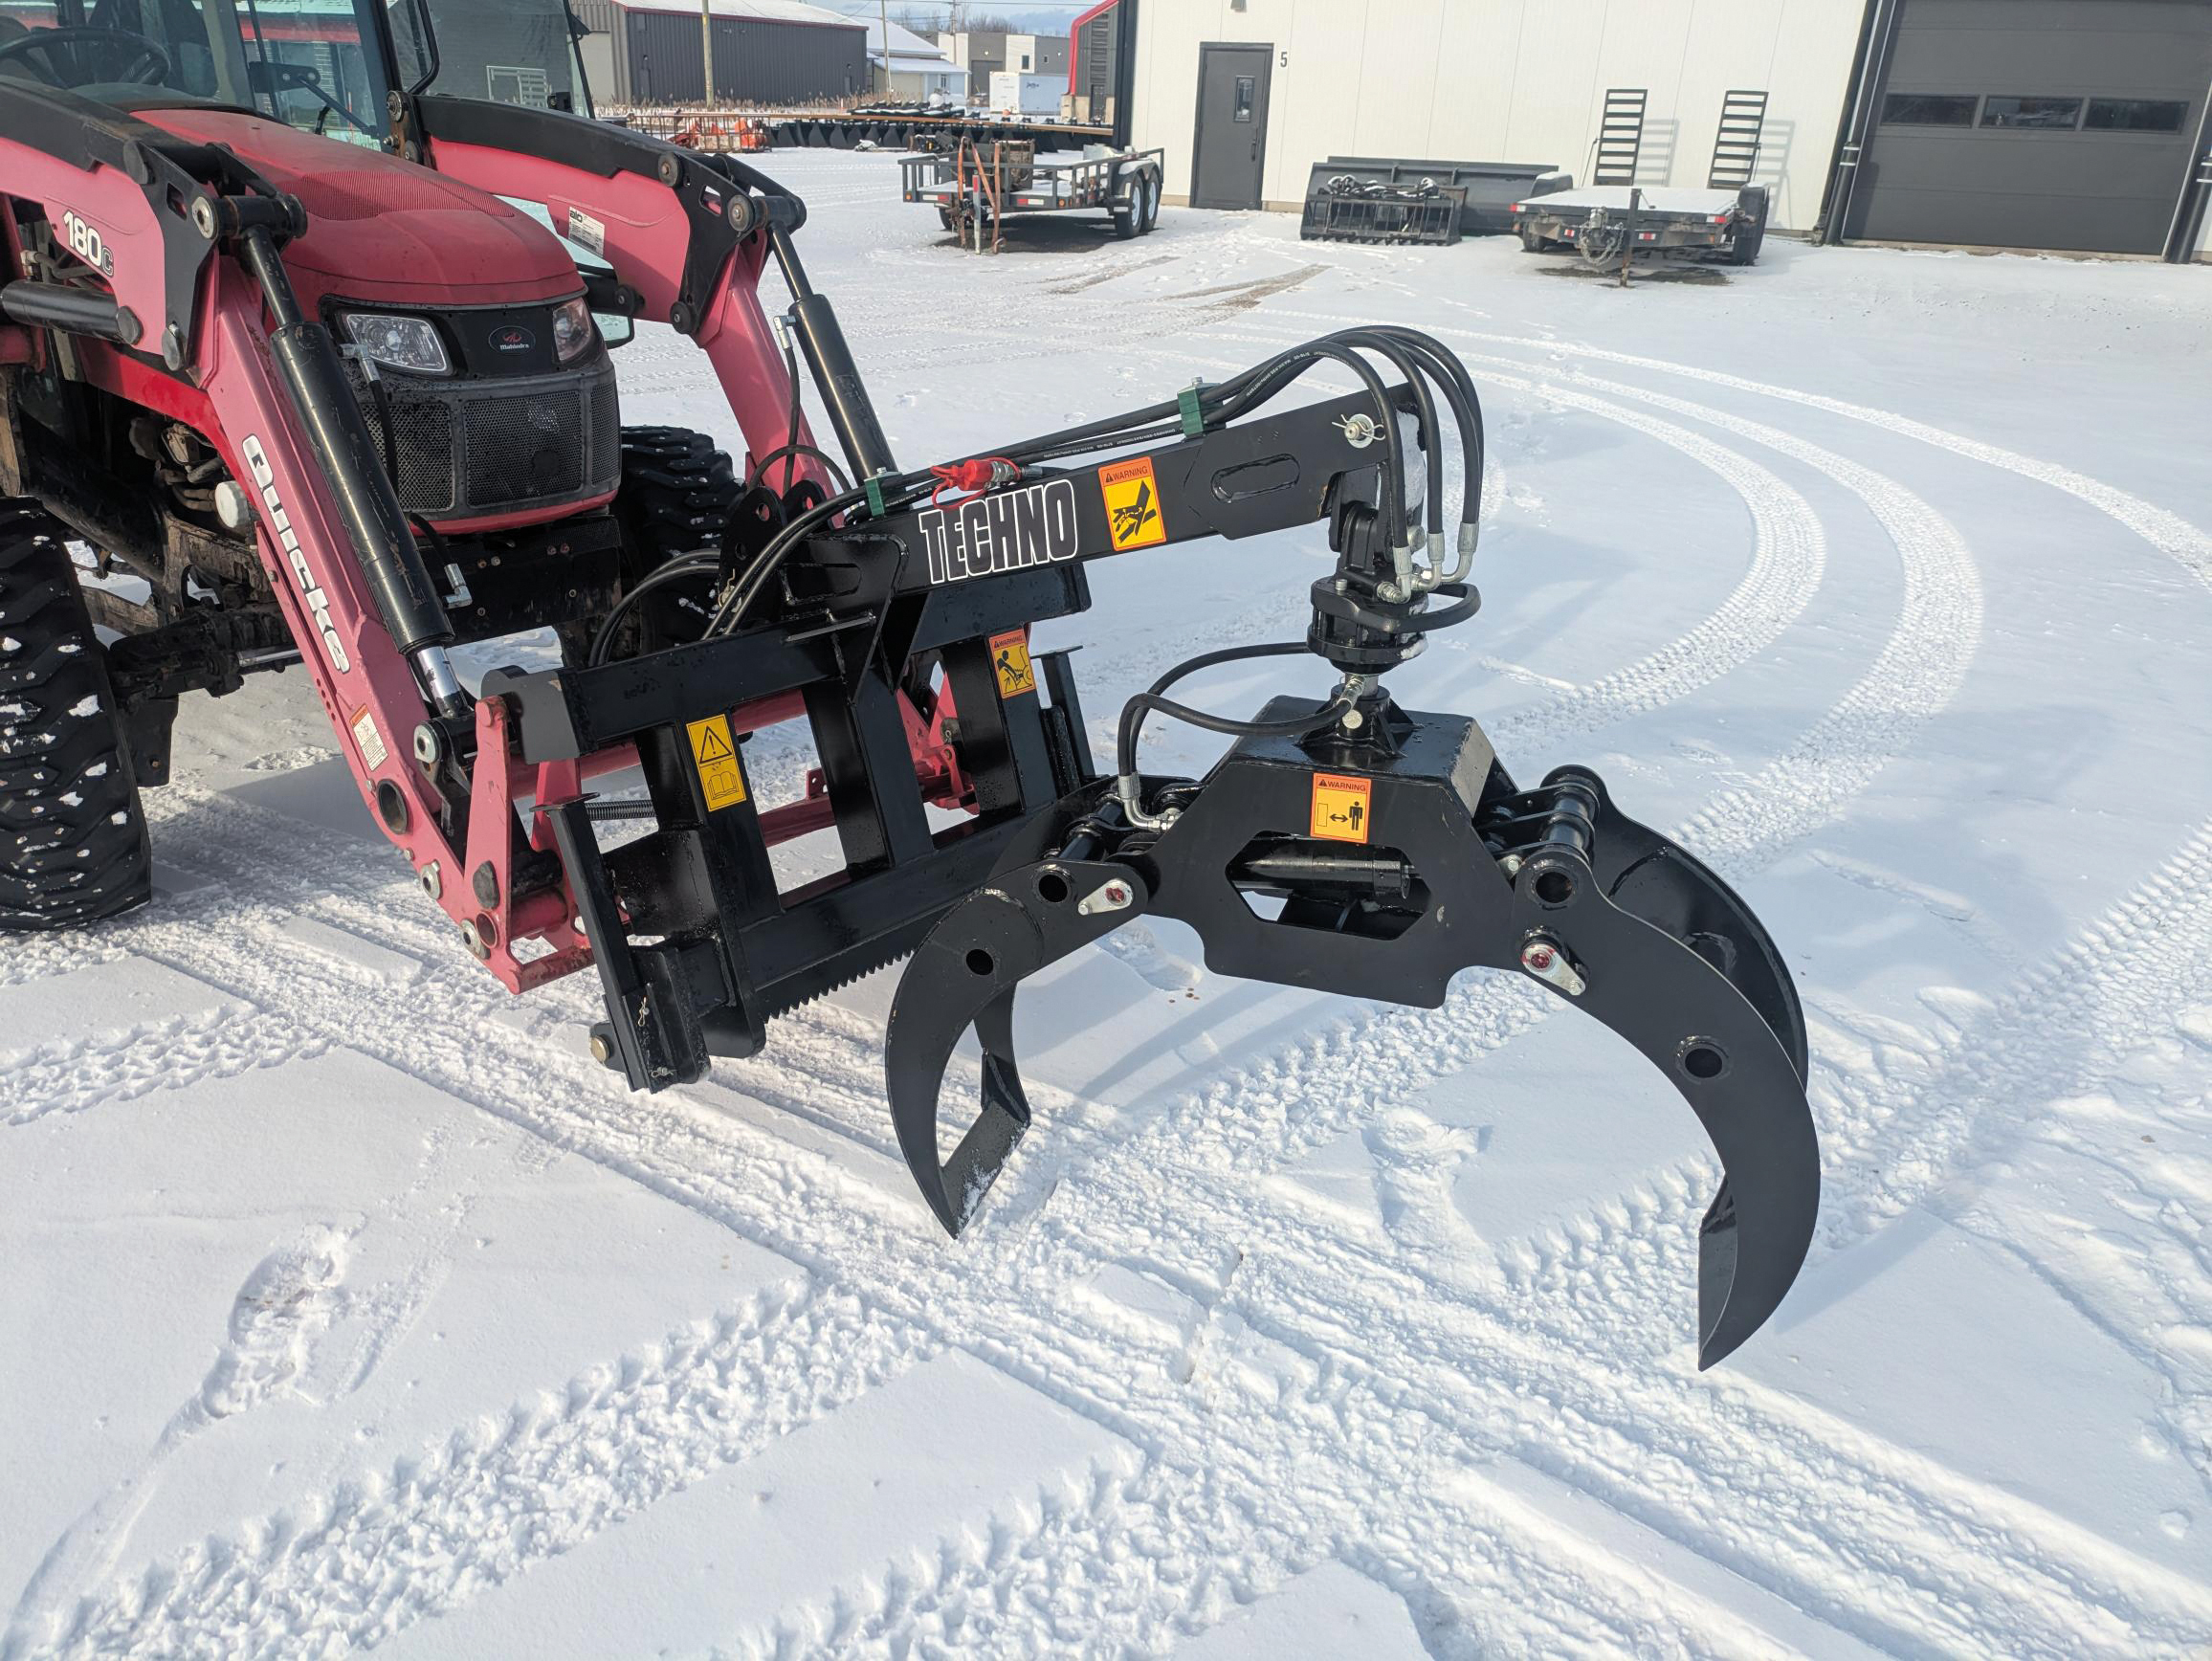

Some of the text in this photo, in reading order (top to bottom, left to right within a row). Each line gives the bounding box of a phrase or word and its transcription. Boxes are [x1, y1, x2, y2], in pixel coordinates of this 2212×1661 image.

[1280, 51, 1288, 68] 5
[499, 343, 530, 351] Mahindra
[1112, 465, 1148, 481] WARNING
[918, 478, 1078, 585] TECHNO
[998, 634, 1023, 647] WARNING
[1327, 780, 1366, 791] WARNING
